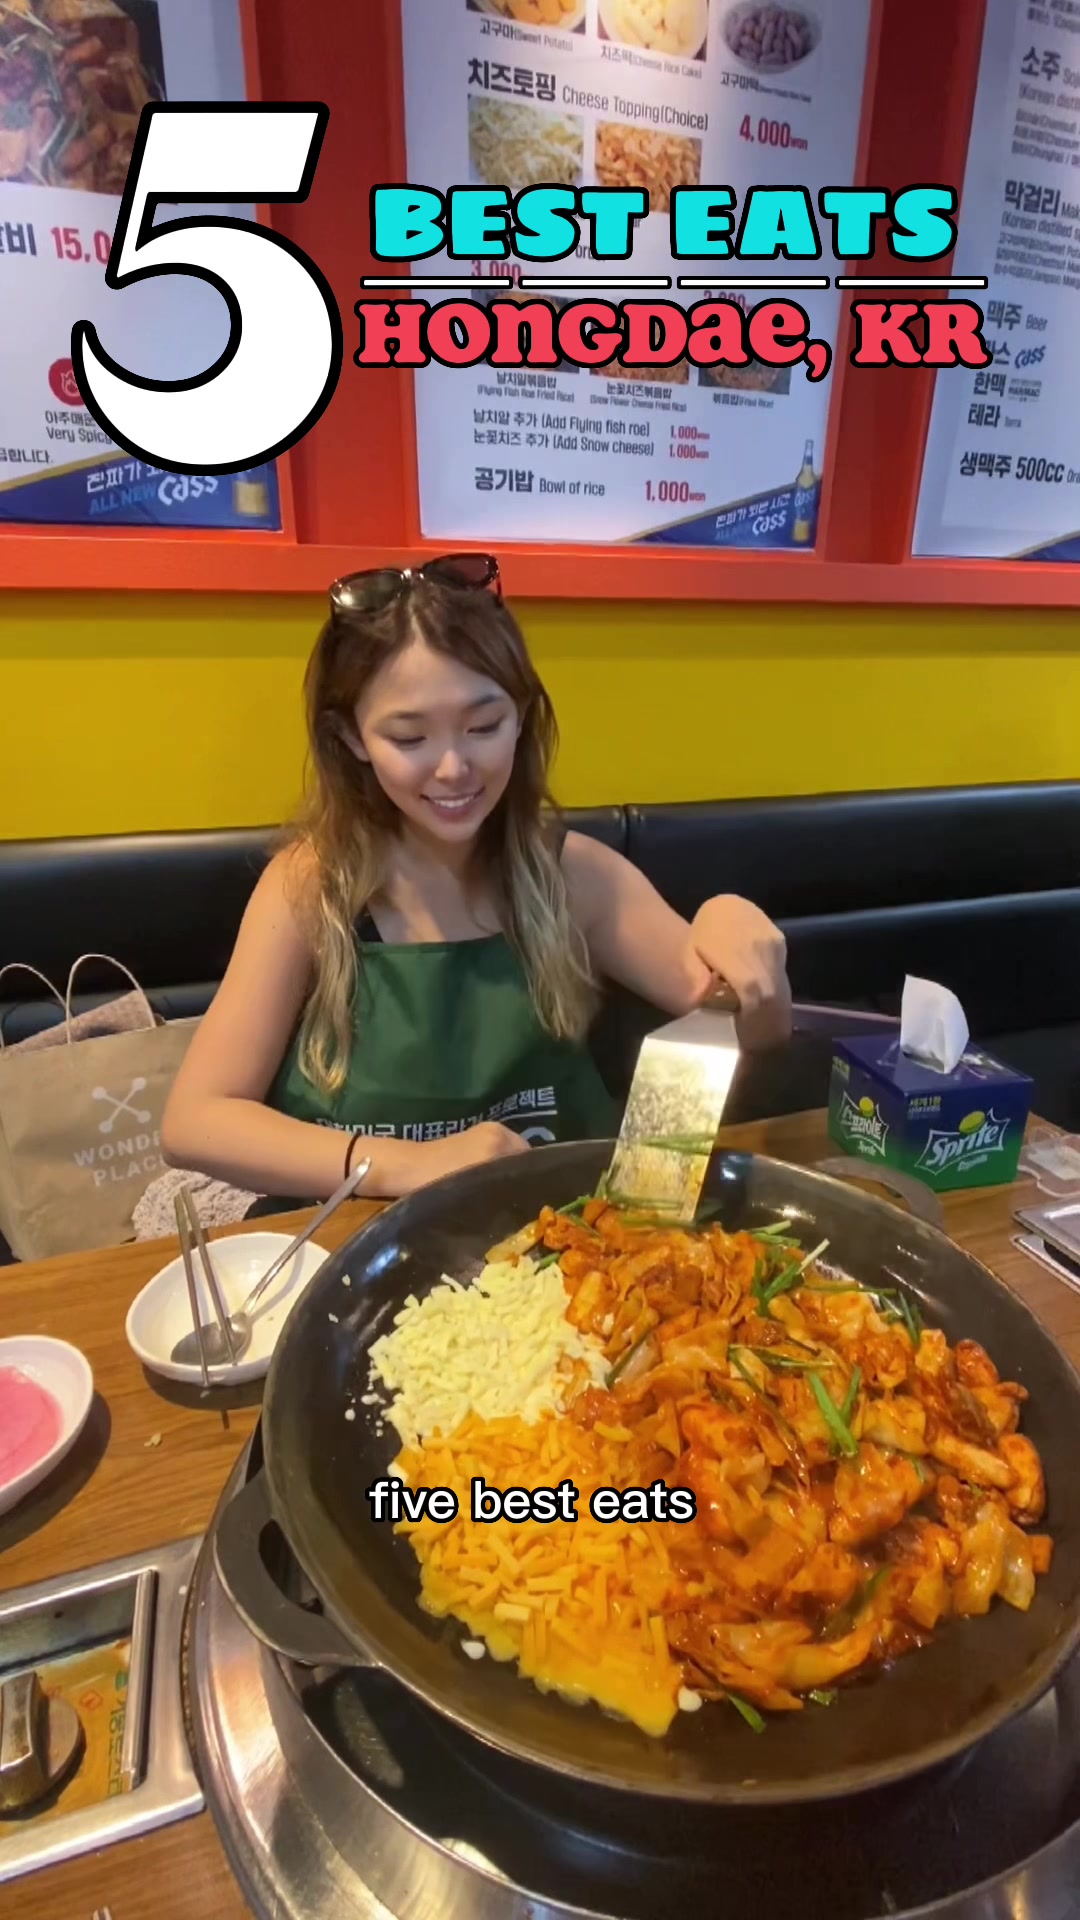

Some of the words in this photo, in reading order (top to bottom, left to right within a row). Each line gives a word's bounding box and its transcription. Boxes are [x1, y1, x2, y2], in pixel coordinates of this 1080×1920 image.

[1021, 46, 1061, 81] 소주
[468, 57, 556, 102] 치즈토핑
[562, 85, 609, 112] Cheese
[1005, 180, 1060, 217] 막걸리
[0, 221, 37, 256] 비
[986, 300, 1022, 331] 맥주
[1025, 314, 1048, 331] Beer
[504, 387, 520, 397] Fish
[973, 371, 1006, 398] 한맥
[513, 412, 537, 428] 추가
[541, 414, 566, 430] (Add
[570, 416, 602, 435] Flying
[606, 419, 626, 435] fish
[628, 422, 650, 437] roe)
[968, 403, 1000, 428] 테라
[46, 427, 75, 443] Very
[78, 428, 112, 445] Spicy
[473, 429, 522, 446] 눈꽃치즈
[525, 432, 549, 448] 추가
[553, 434, 578, 451] (Add
[580, 436, 609, 453] Snow
[612, 440, 654, 456] cheese)
[475, 467, 534, 493] 공기밥
[539, 477, 566, 493] Bowl
[569, 479, 581, 495] of
[583, 481, 605, 497] rice
[960, 451, 1012, 479] 생맥주
[1015, 457, 1065, 483] 500cc
[73, 1129, 161, 1168] WOND
[925, 1121, 1000, 1167] Sprite
[93, 1153, 162, 1188] PLAC
